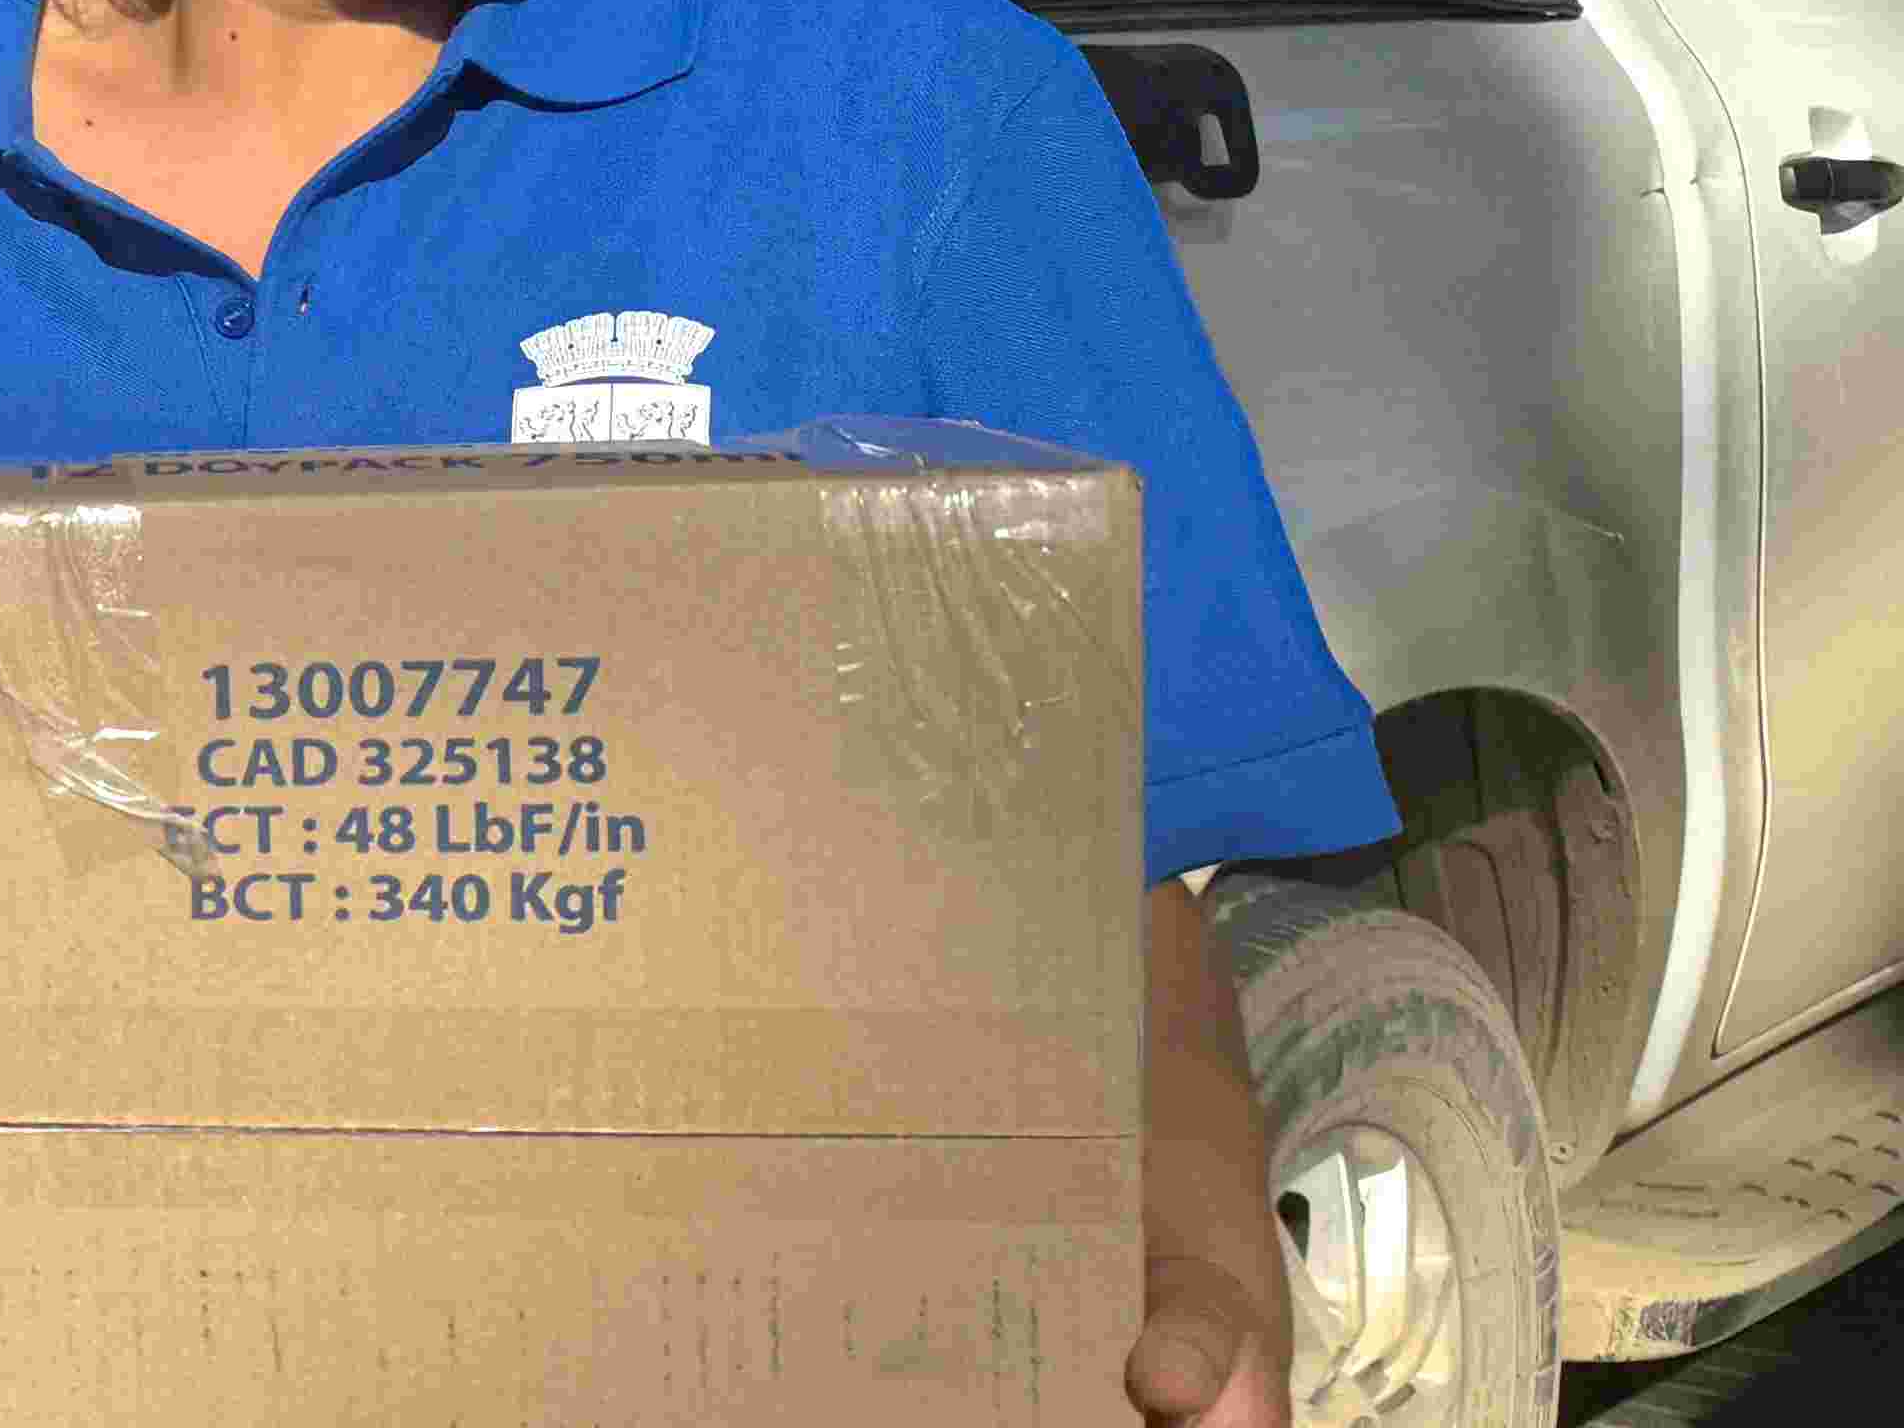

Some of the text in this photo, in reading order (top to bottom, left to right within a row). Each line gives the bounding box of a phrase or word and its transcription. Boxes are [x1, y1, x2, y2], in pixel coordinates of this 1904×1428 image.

[144, 457, 485, 476] DOYPACK
[202, 656, 601, 720] 13007747
[196, 735, 608, 788] CAD 325138
[335, 806, 417, 854] 48
[434, 801, 646, 856] LbF/in
[191, 873, 316, 923] BCT
[369, 873, 492, 923] 340
[509, 869, 627, 934] Kgf
